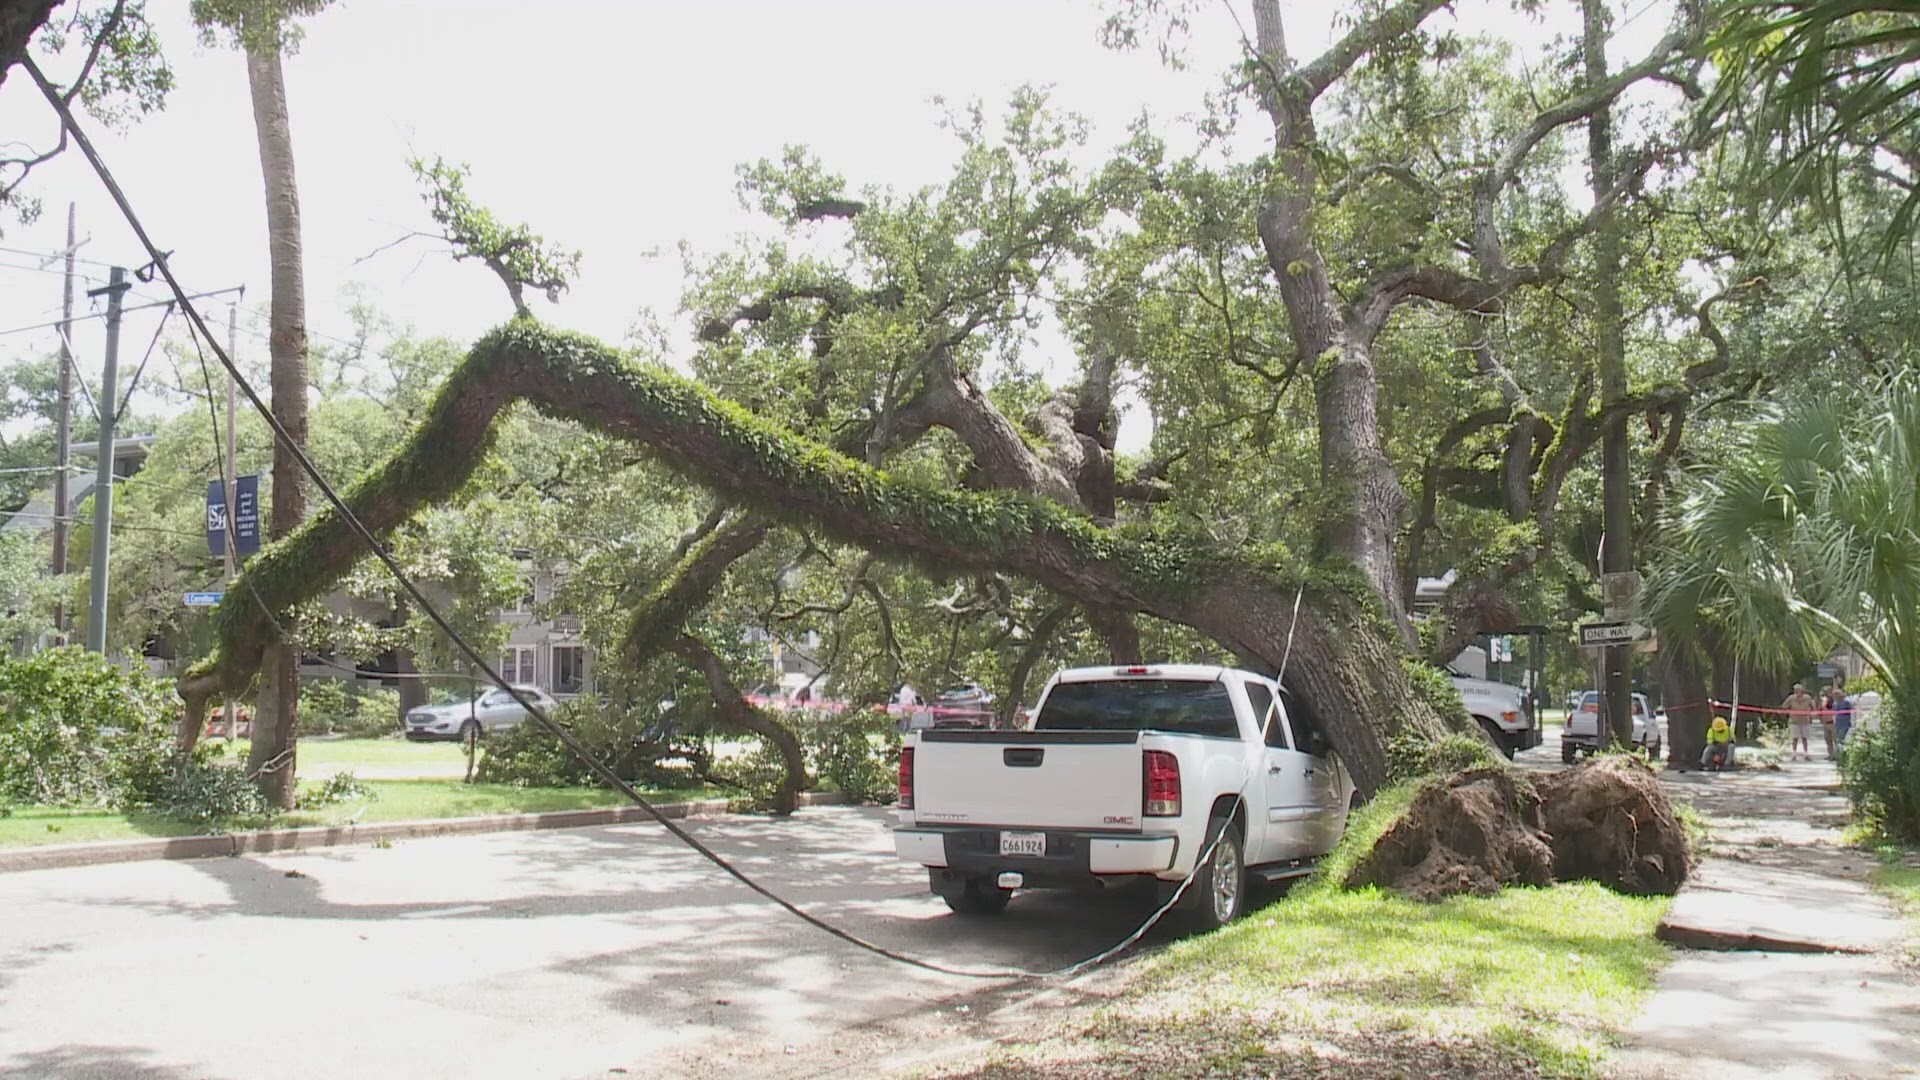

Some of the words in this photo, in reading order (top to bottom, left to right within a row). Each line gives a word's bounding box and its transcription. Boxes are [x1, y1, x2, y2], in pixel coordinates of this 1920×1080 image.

[1586, 630, 1606, 639] ONE
[1610, 627, 1630, 638] WAY
[1103, 816, 1133, 825] GMC
[1002, 839, 1043, 852] C661924
